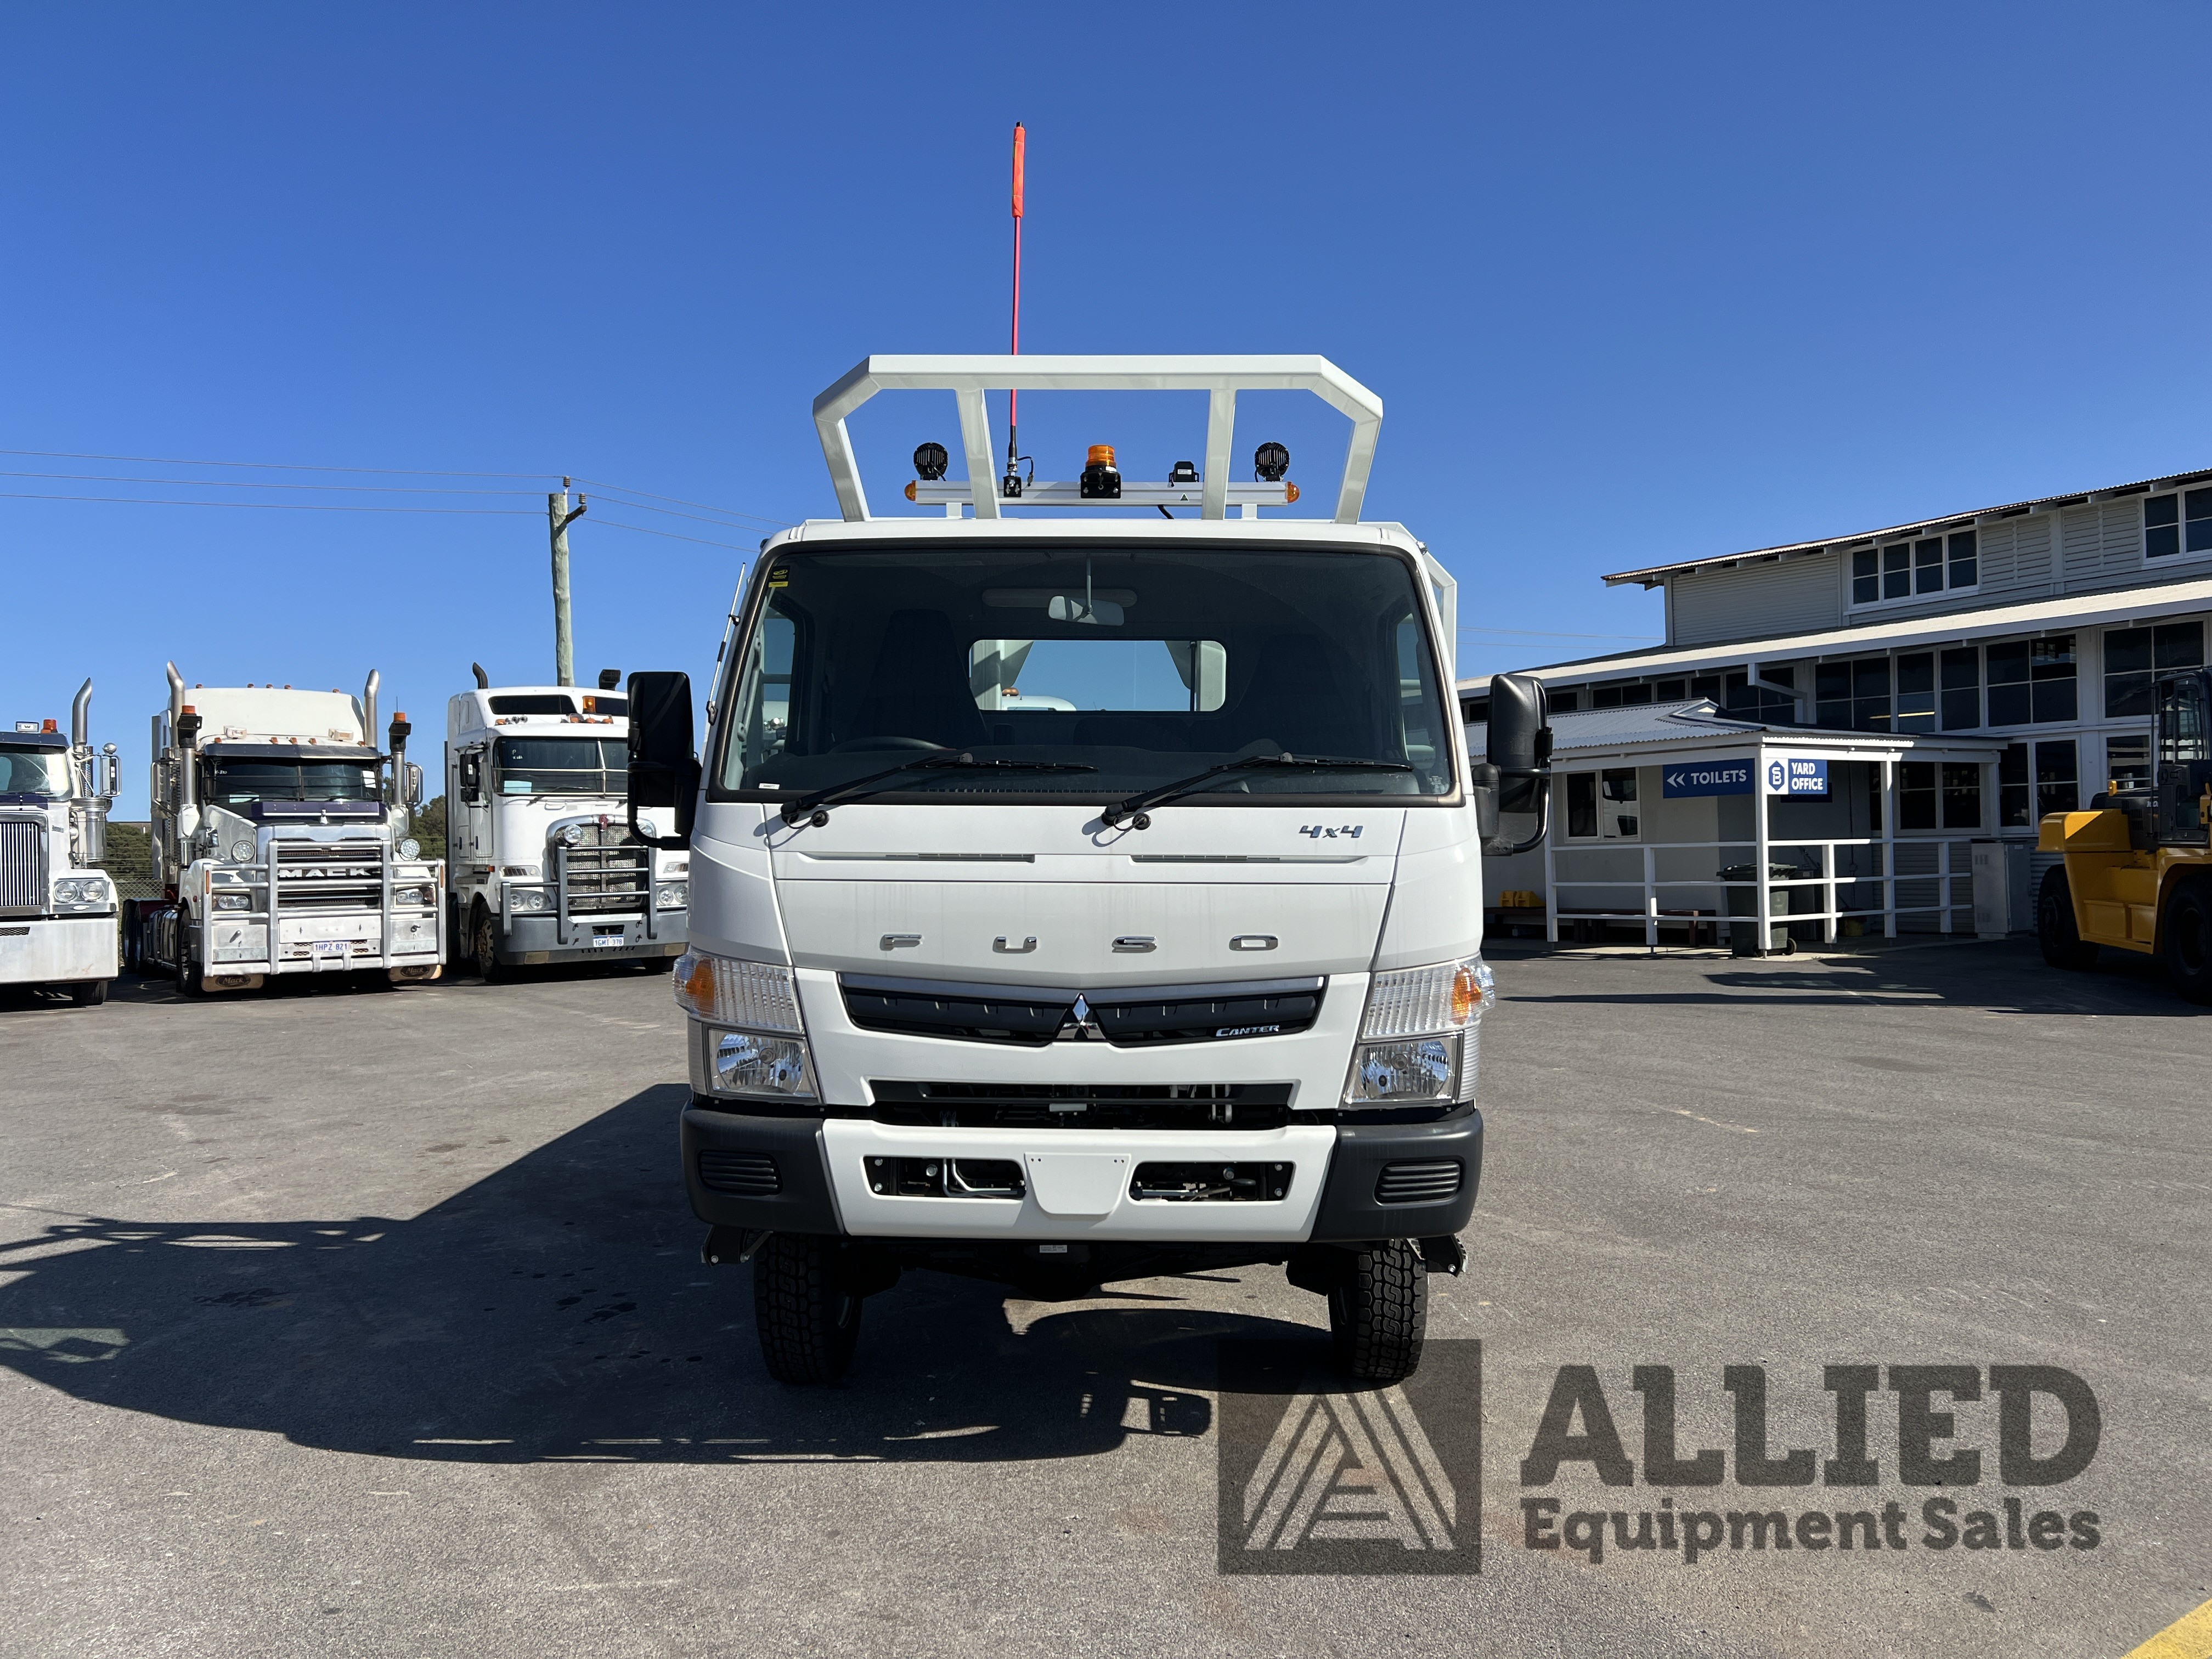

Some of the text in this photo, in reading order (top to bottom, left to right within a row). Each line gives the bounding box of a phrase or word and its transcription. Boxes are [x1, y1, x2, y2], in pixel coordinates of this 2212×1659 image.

[1791, 762, 1815, 775] YARD
[1690, 770, 1747, 785] TOILETS
[1791, 777, 1823, 790] OFFICE
[1298, 825, 1364, 838] 4x4
[279, 868, 371, 877] MACK
[880, 934, 1279, 953] FUSO
[1216, 1025, 1279, 1037] CANTER
